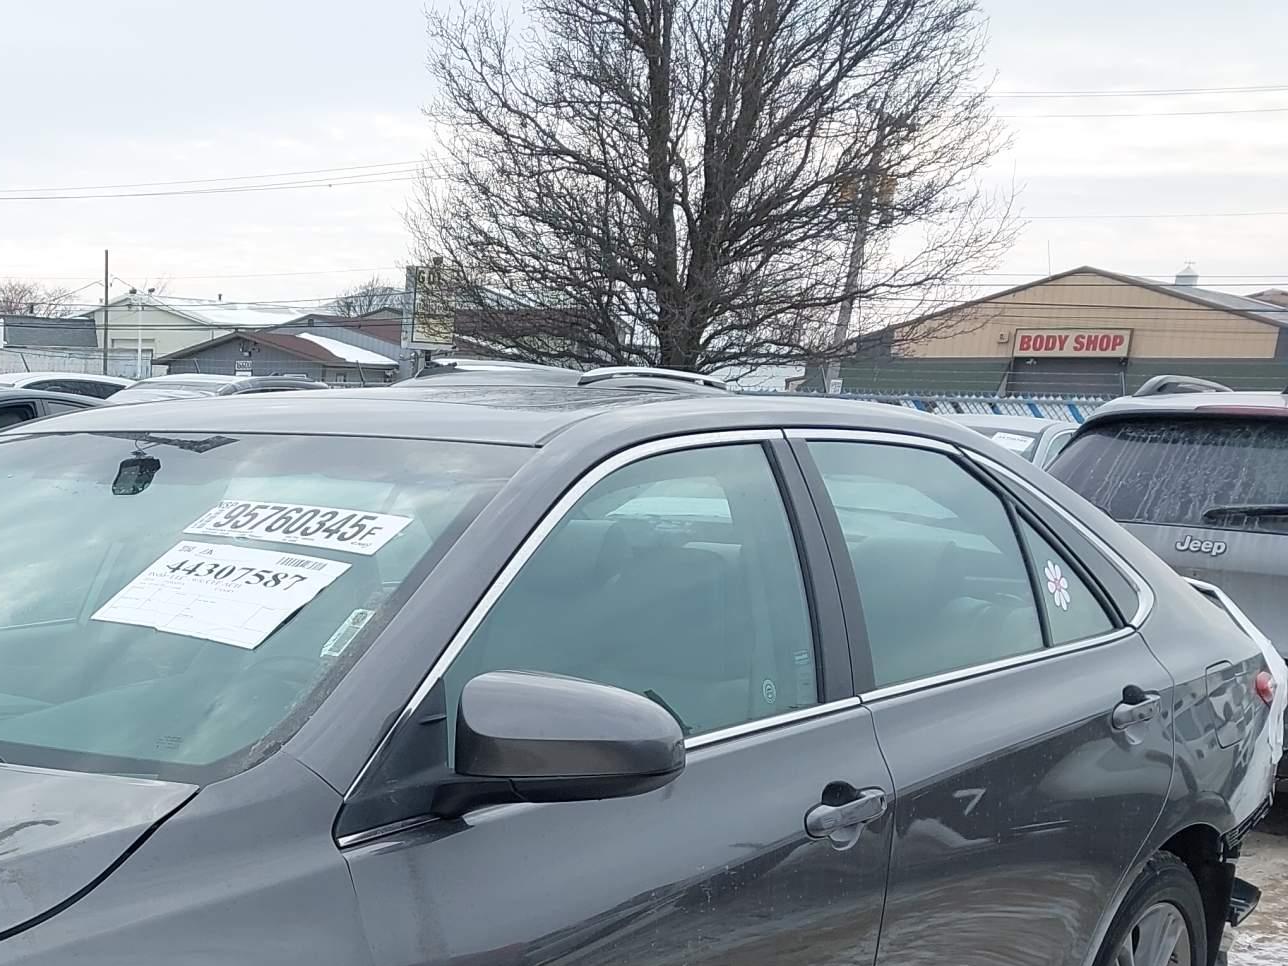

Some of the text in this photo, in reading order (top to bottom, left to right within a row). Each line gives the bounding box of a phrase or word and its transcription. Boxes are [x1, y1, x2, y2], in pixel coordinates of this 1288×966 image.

[1019, 334, 1125, 352] BODY SHOP
[213, 502, 379, 542] 95760345
[1175, 534, 1227, 557] Jeep
[166, 559, 308, 591] 44307587
